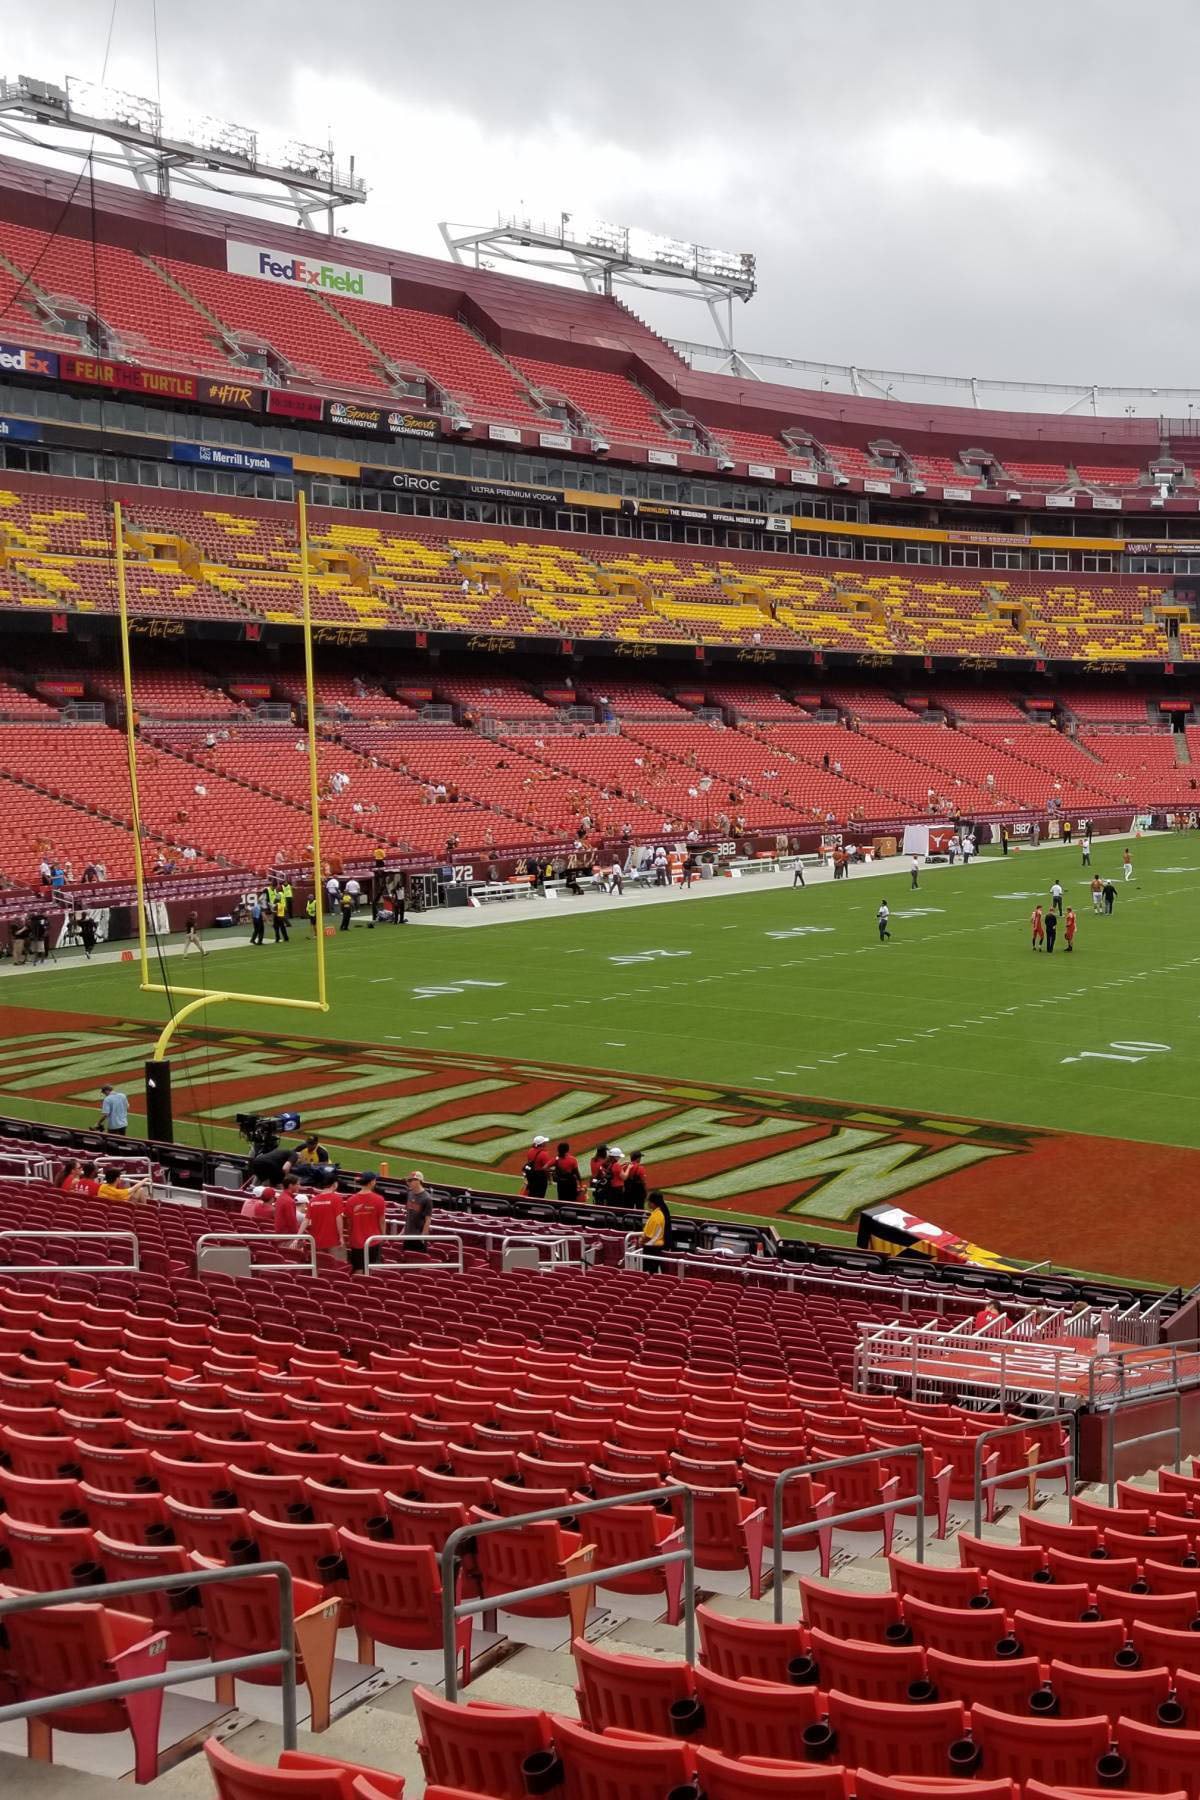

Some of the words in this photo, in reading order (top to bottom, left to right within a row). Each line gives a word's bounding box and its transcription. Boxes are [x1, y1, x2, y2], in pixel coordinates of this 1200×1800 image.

[259, 252, 363, 296] FedExField
[0, 346, 49, 374] edEx
[346, 405, 380, 421] Sports
[331, 416, 378, 429] WASHINGTON
[403, 415, 437, 431] Sports
[389, 425, 434, 438] WASHINGTON
[212, 451, 242, 466] Merrill
[246, 455, 271, 469] Lynch
[471, 486, 495, 496] ULTRA
[496, 489, 531, 499] PREMIUM
[532, 493, 557, 502] VODKA
